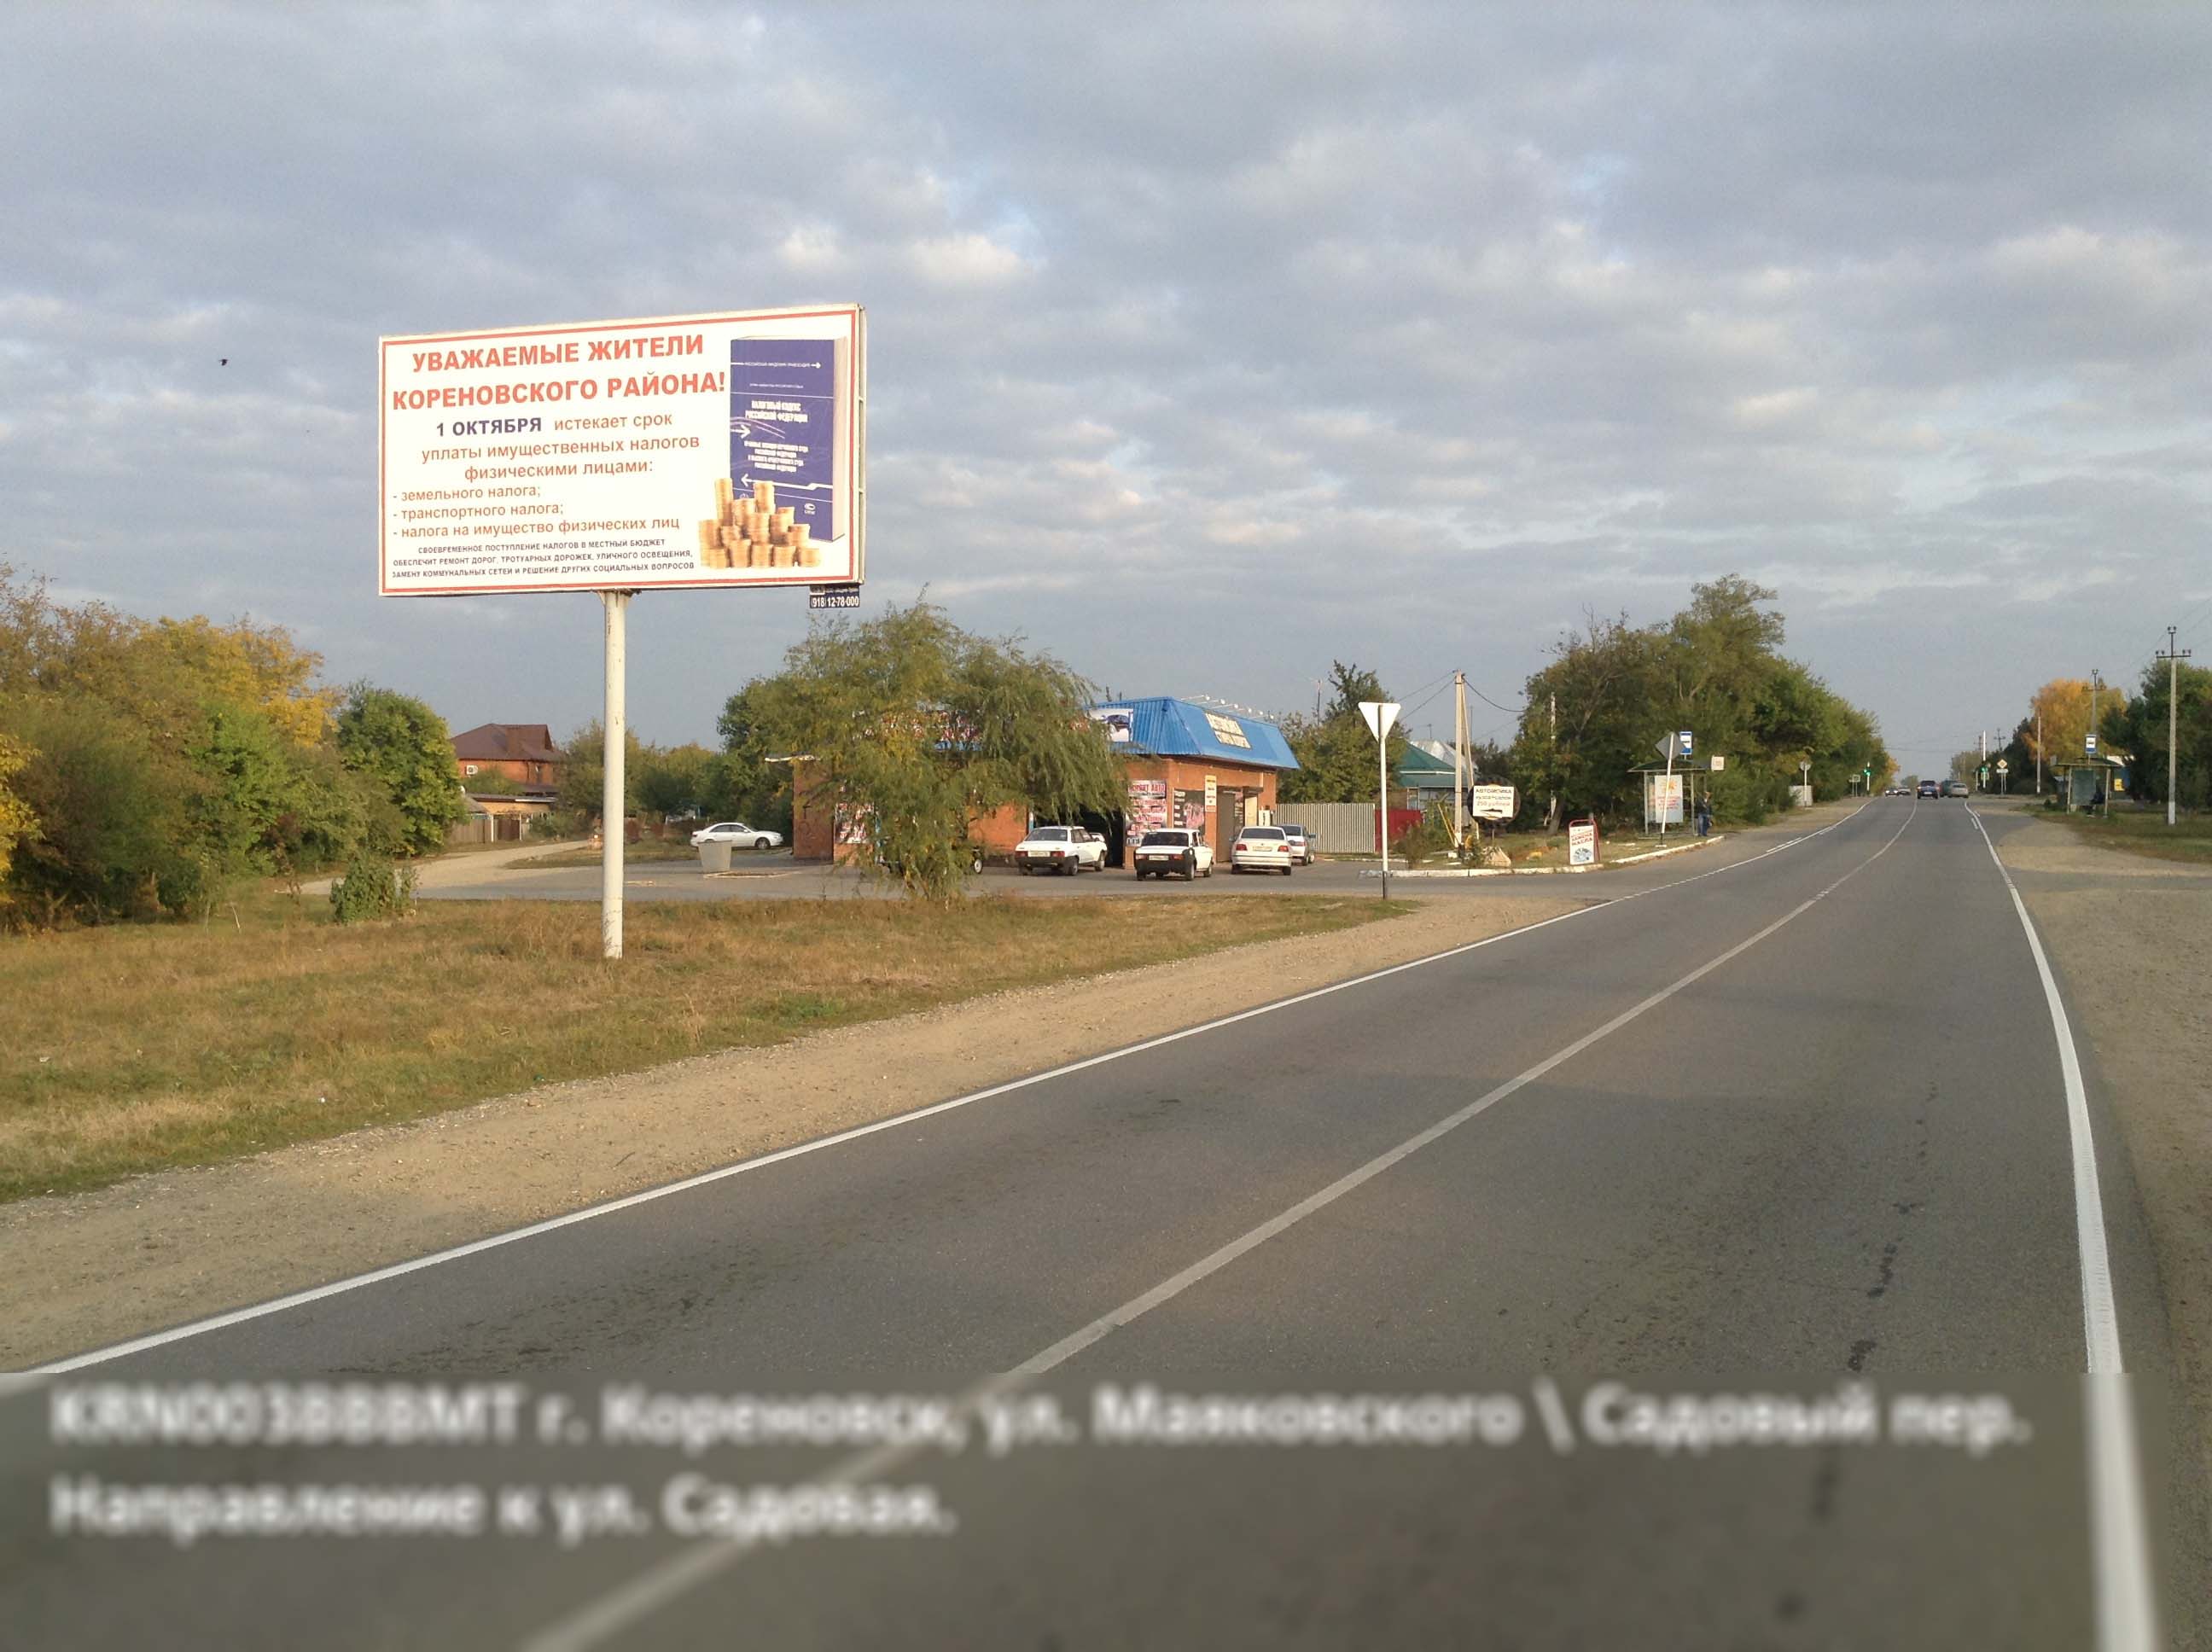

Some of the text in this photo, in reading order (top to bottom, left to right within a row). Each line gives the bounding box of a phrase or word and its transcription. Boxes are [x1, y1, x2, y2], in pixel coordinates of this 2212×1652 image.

[412, 334, 703, 373] УВАЖАЕМЫЕ ЖИТЕЛИ
[393, 369, 725, 410] КОРЕНОВСКОГО РАЙОНА!
[436, 413, 672, 437] 1 ОКТЯБРЯ истекает срок
[422, 436, 701, 465] уплаты имущественных налогов
[464, 460, 654, 484] физическими лицами:
[400, 488, 484, 502] земельного
[488, 486, 541, 498] налога;
[401, 506, 506, 522] транспортного
[511, 503, 563, 516] налога;
[401, 526, 449, 538] налога
[453, 526, 469, 537] на
[474, 522, 554, 538] имущество
[558, 519, 647, 536] физических
[651, 518, 680, 531] лиц
[485, 544, 540, 552] ПОСТУПЛЕНИЕ
[543, 542, 579, 550] НАЛОГОВ
[588, 540, 627, 549] МЕСТНЫЙ
[630, 538, 666, 547] БЮДЖЕТ
[501, 555, 551, 564] ТРОТУАРНЫХ
[597, 552, 638, 561] УЛИЧНОГО
[422, 569, 486, 578] КОММУНАЛЬНЫХ
[488, 567, 513, 575] СЕТЕЙ
[522, 565, 559, 575] РЕШЕНИЕ
[561, 566, 591, 574] ДРУГИХ
[593, 563, 649, 573] СОЦИАЛЬНЫХ
[651, 561, 695, 571] ВОПРОСОВ
